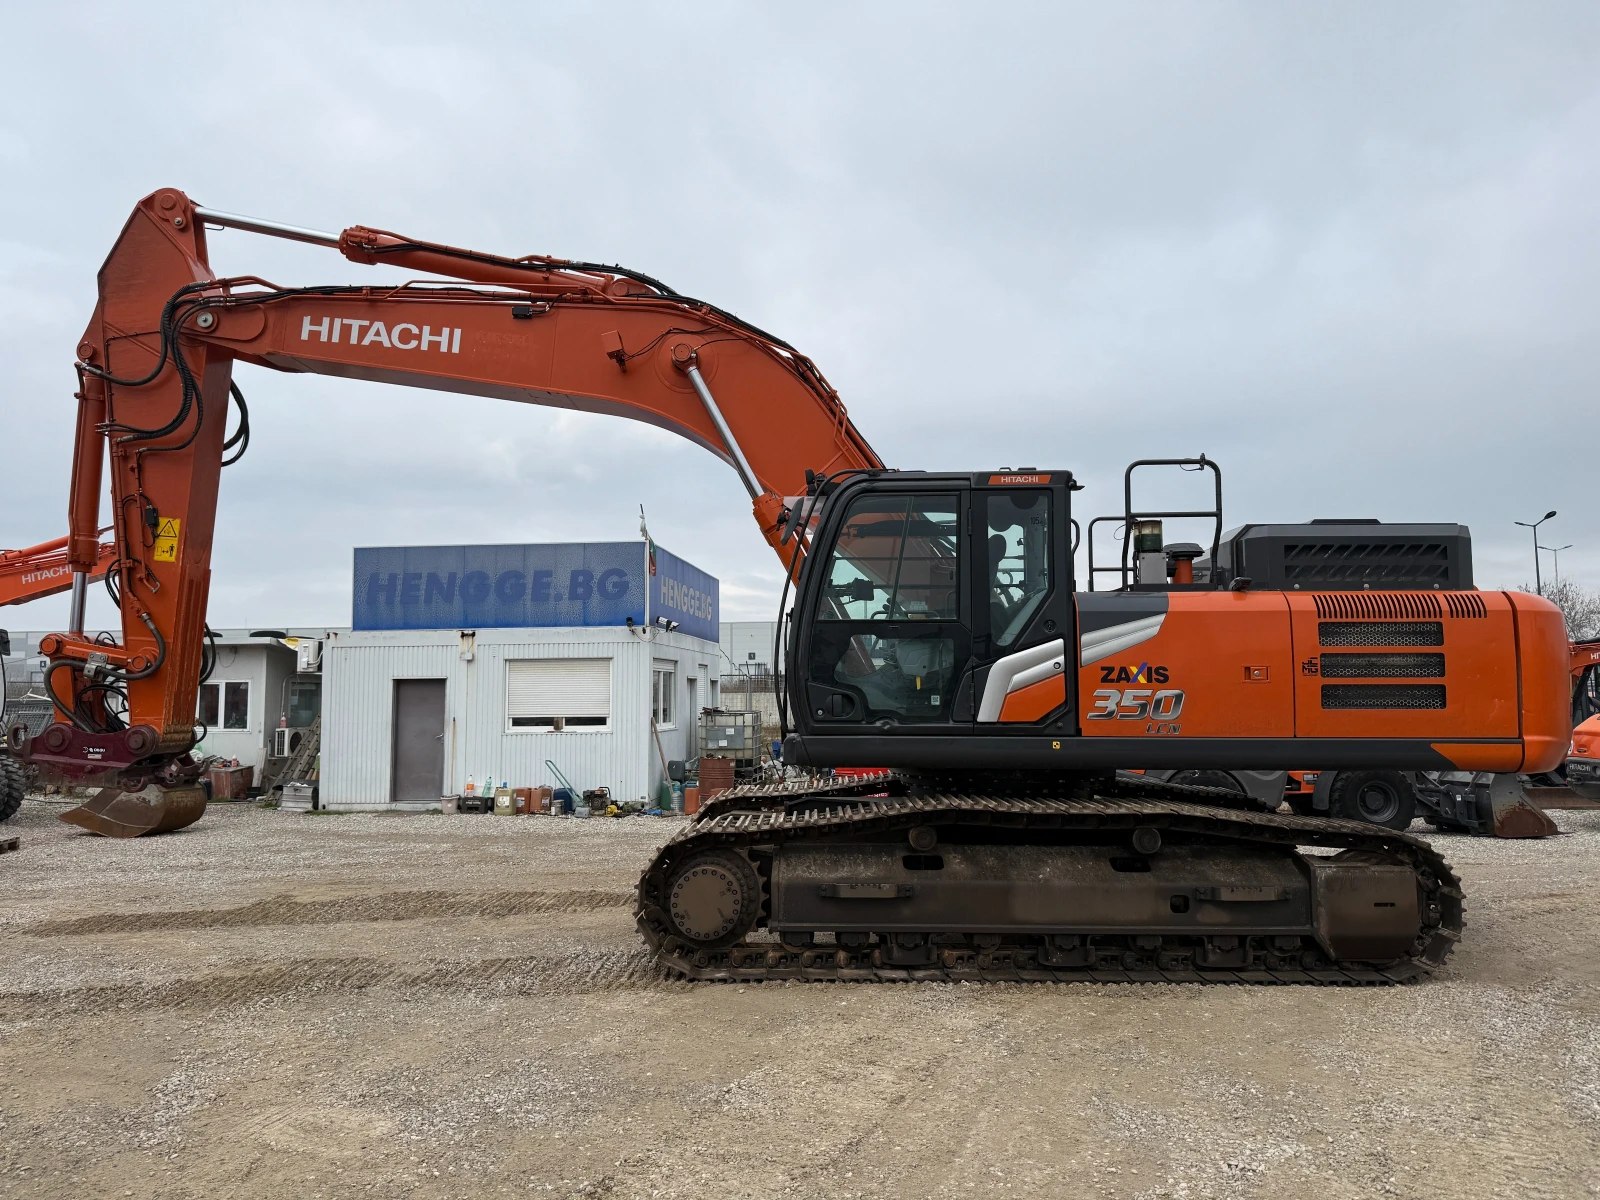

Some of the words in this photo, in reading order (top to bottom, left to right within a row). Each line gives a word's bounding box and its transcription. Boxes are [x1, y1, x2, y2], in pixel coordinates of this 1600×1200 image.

[300, 315, 462, 354] HITACHI
[1001, 475, 1039, 483] HITACHI
[21, 563, 72, 585] HITACHI
[366, 567, 630, 605] HENGGE.BG
[660, 574, 713, 621] HENGGE.BG
[1100, 662, 1169, 684] ZAXIS
[1087, 689, 1185, 720] 350
[1146, 723, 1181, 734] LCN
[1569, 763, 1591, 772] HITACHI
